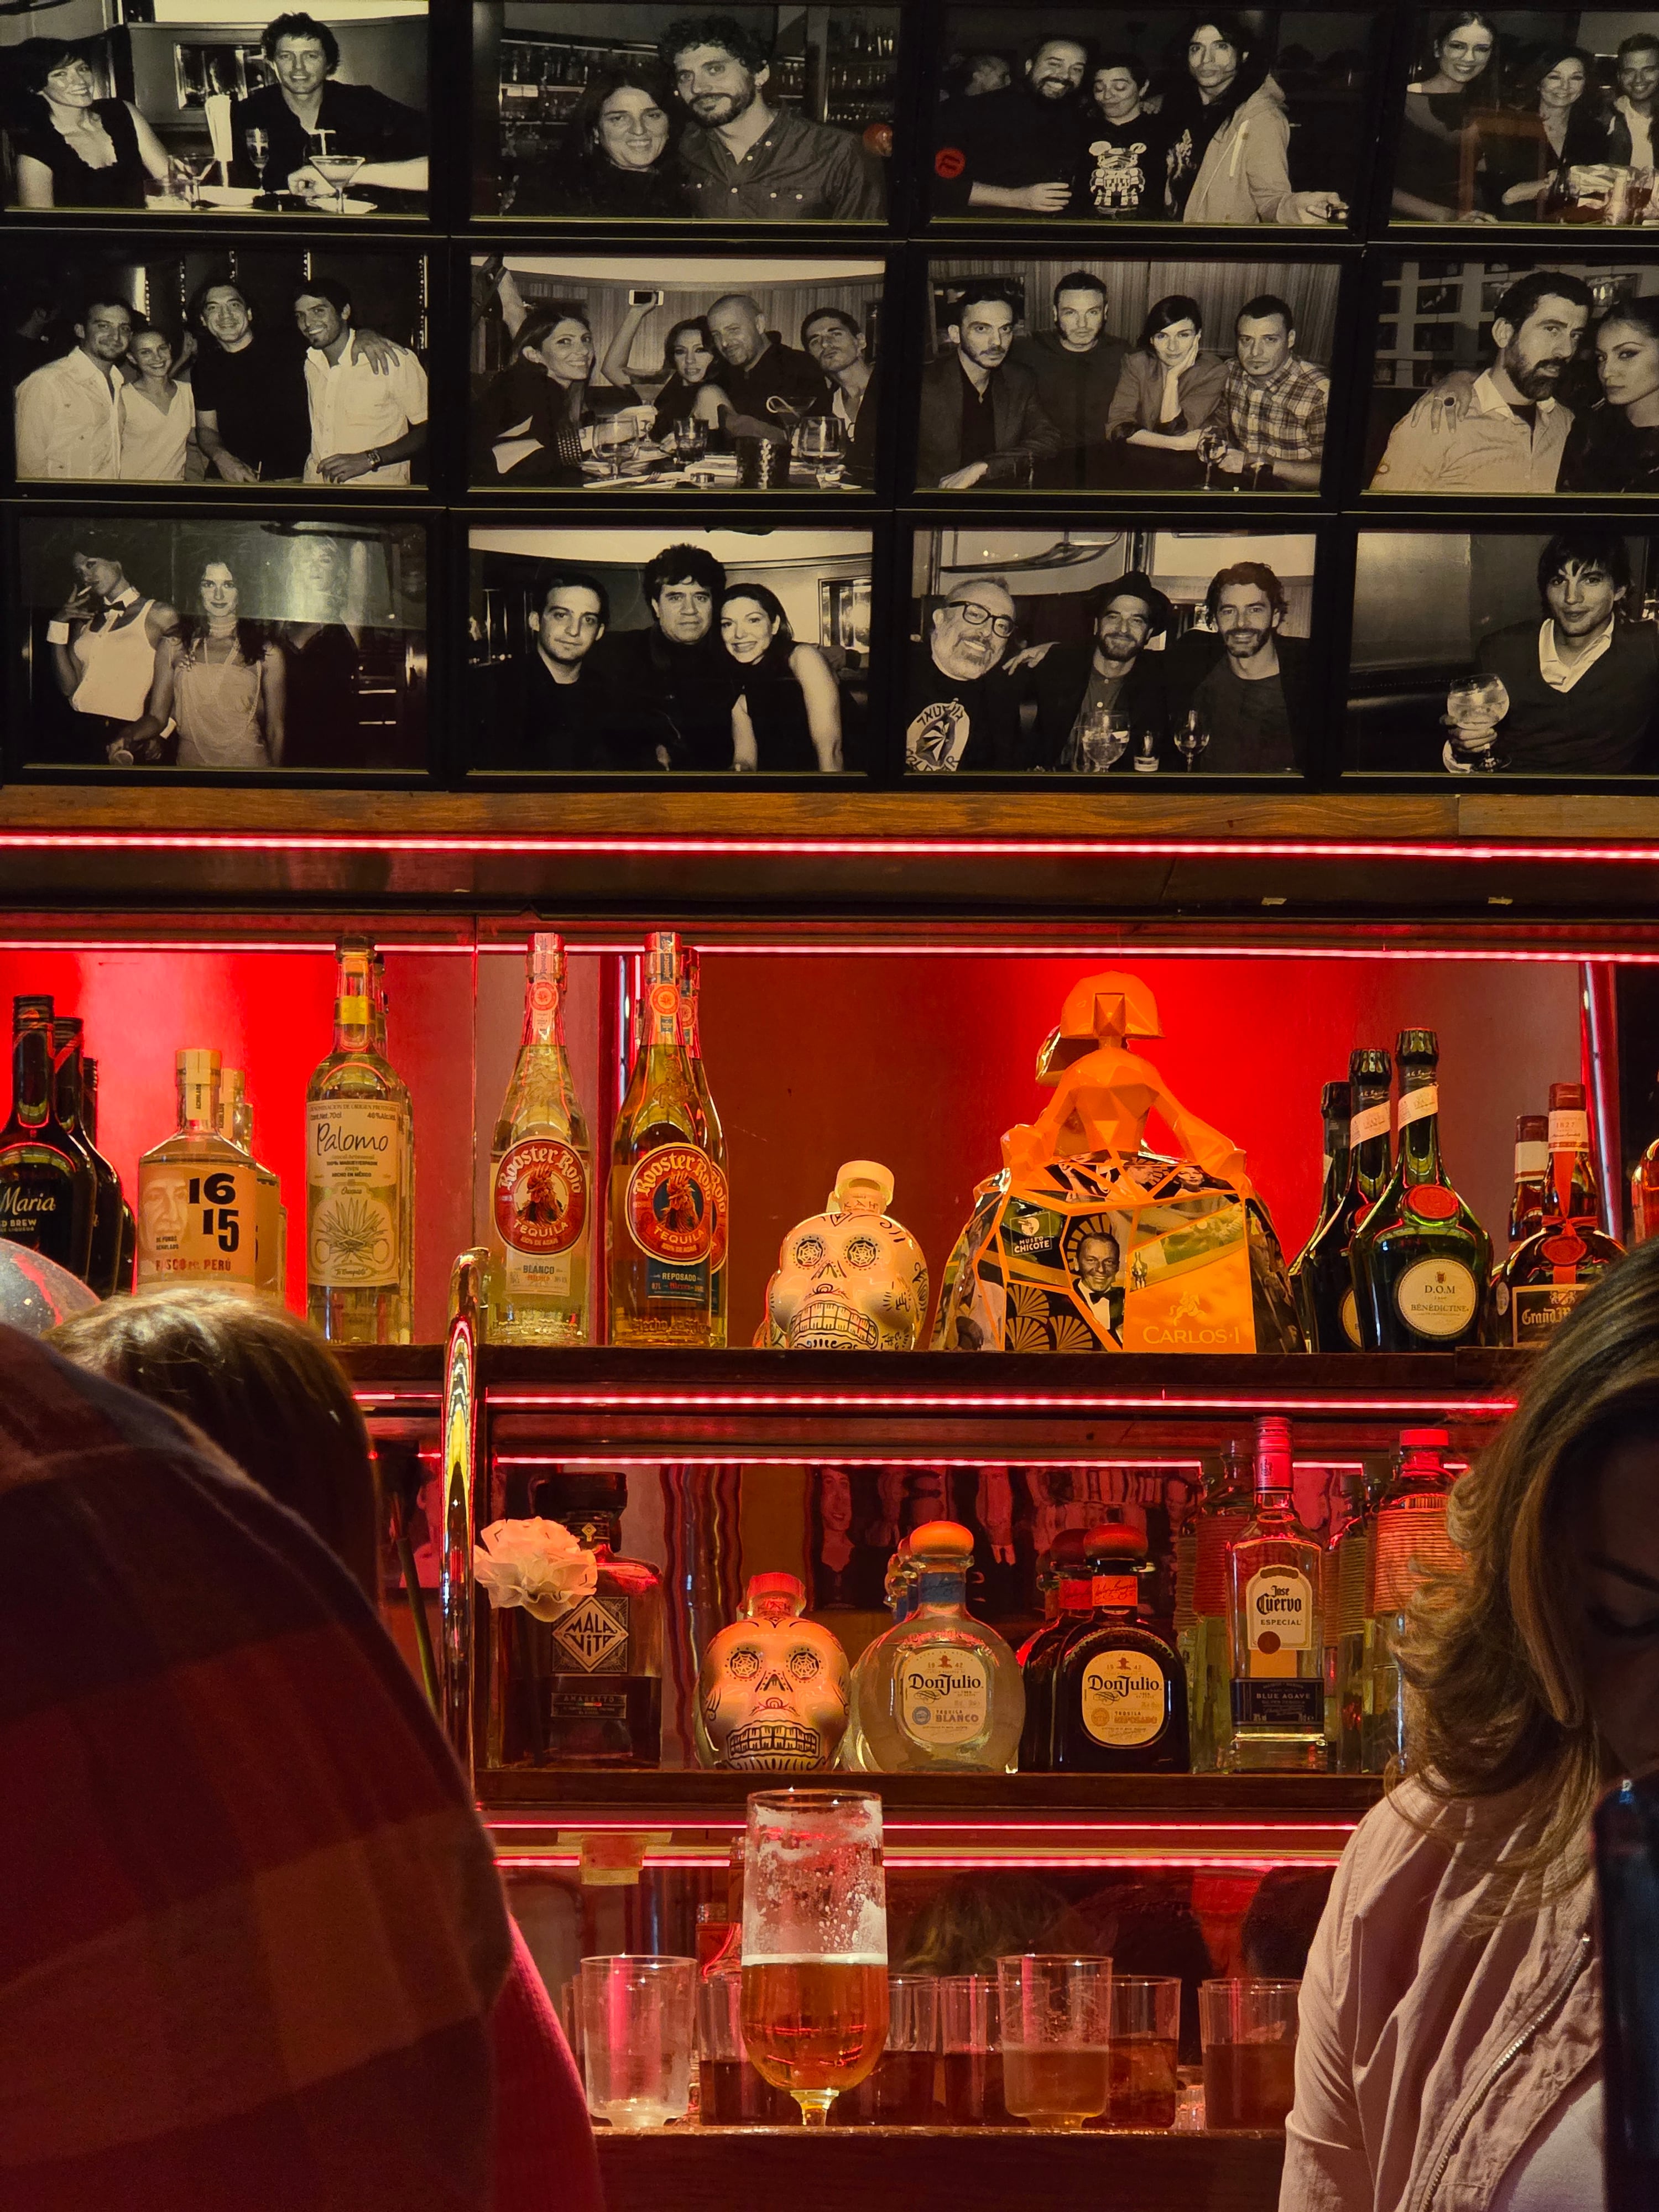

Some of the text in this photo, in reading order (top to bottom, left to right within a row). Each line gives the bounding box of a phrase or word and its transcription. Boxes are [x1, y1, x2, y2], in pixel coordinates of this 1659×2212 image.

[317, 1123, 388, 1156] Palomo
[499, 1146, 582, 1193] Rooster Rojo
[633, 1152, 712, 1201] Rooster Rojo
[189, 1172, 236, 1204] 16
[0, 1186, 56, 1215] Maria
[203, 1208, 239, 1252] 15
[514, 1219, 568, 1237] TEQUILA
[654, 1225, 705, 1244] TEQUILA
[1014, 1240, 1050, 1253] CHICOTE
[1019, 1236, 1044, 1245] MUSEO
[204, 1258, 232, 1271] PERÚ
[523, 1265, 555, 1274] BLANCO
[662, 1272, 697, 1282] REPOSADO
[1522, 1308, 1556, 1325] Grand
[1270, 1585, 1290, 1598] Jose
[1256, 1593, 1302, 1615] Cuervo
[565, 1611, 618, 1634] MALA
[936, 1714, 979, 1723] BLANCO
